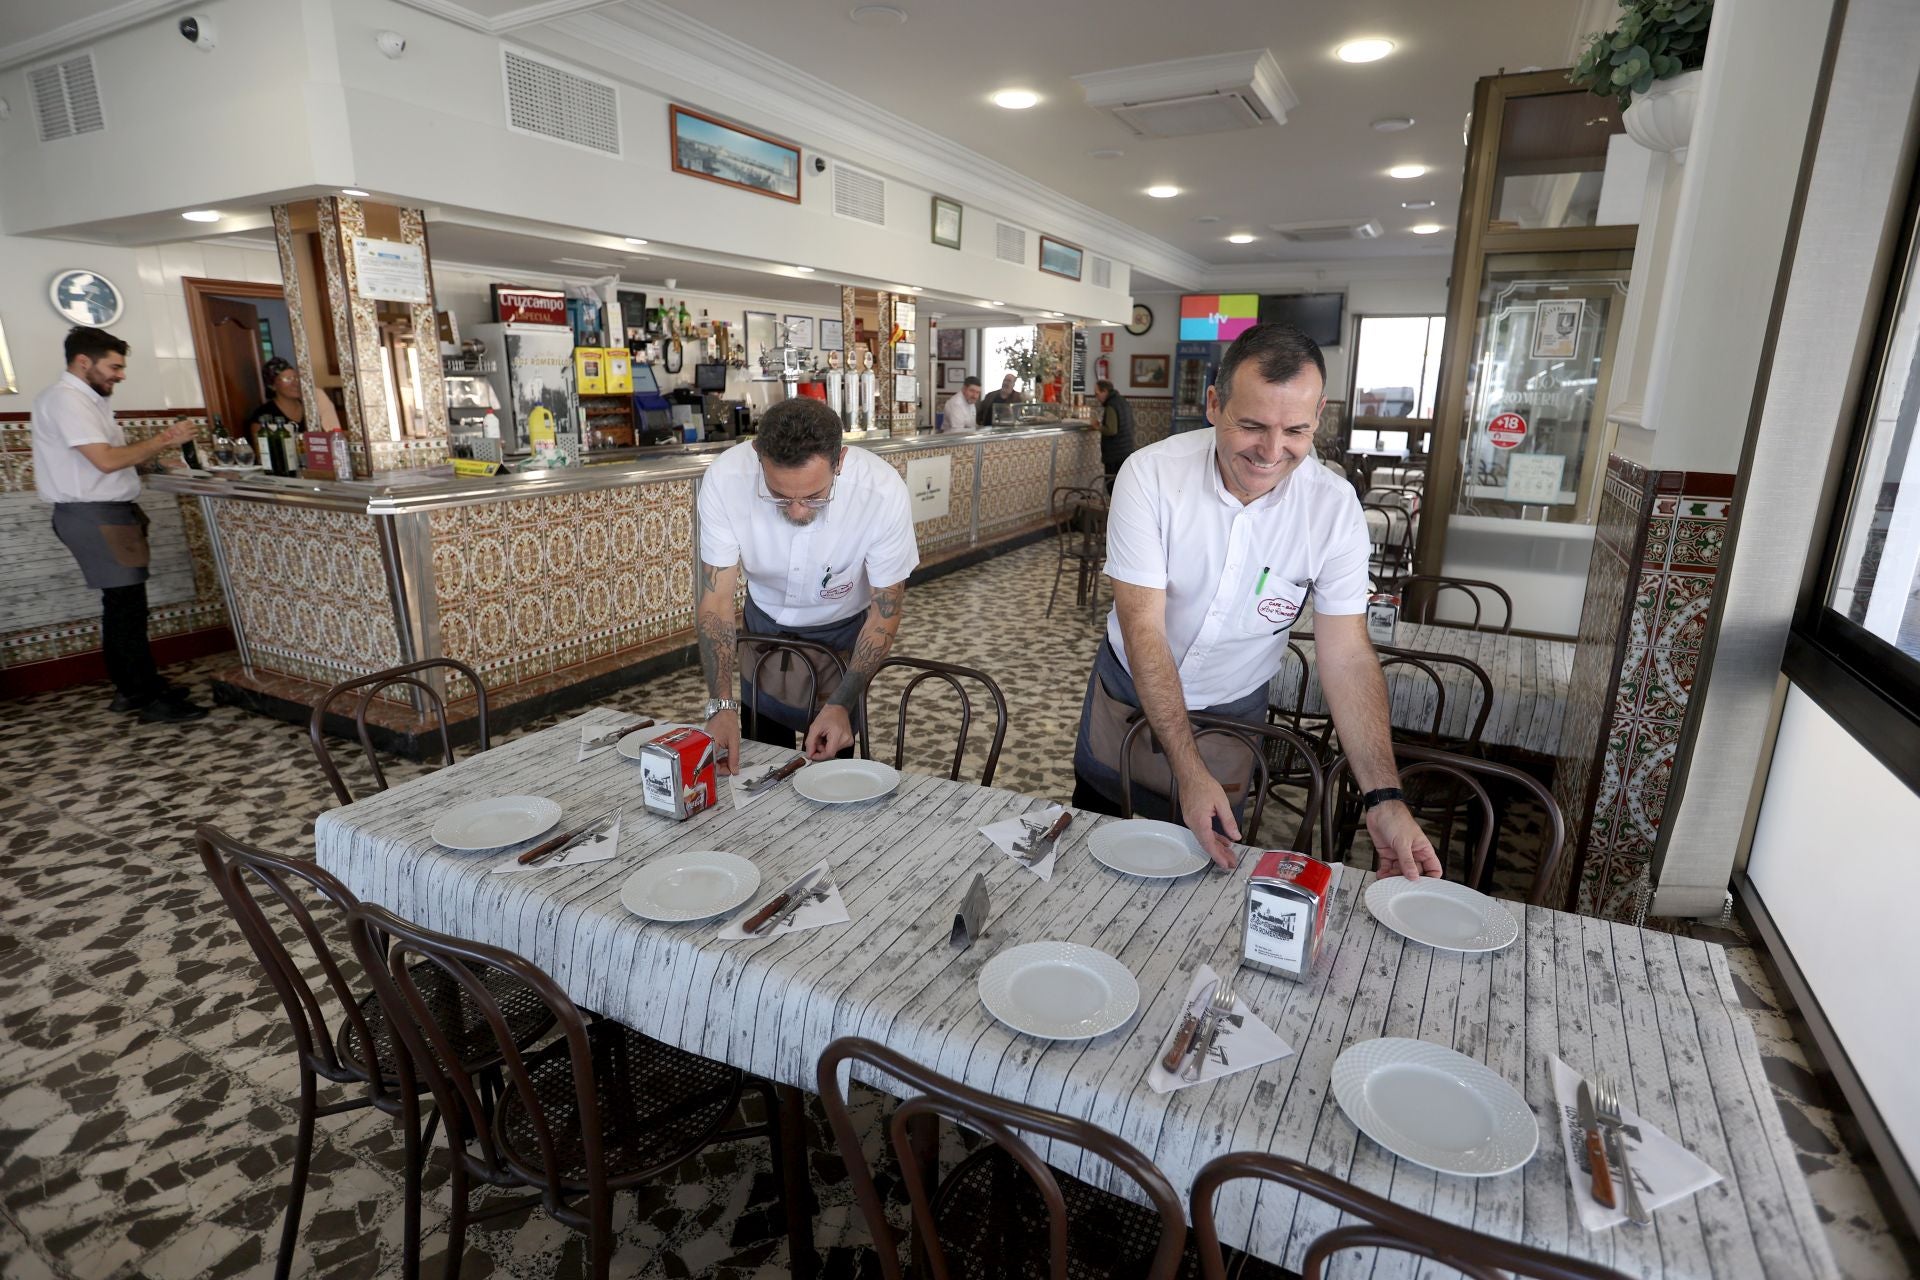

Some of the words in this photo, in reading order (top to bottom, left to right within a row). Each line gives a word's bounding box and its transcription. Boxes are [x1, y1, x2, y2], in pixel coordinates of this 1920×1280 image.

[500, 294, 564, 311] Cruzcampo
[514, 311, 552, 322] ESPECIAL
[1497, 416, 1519, 429] +18
